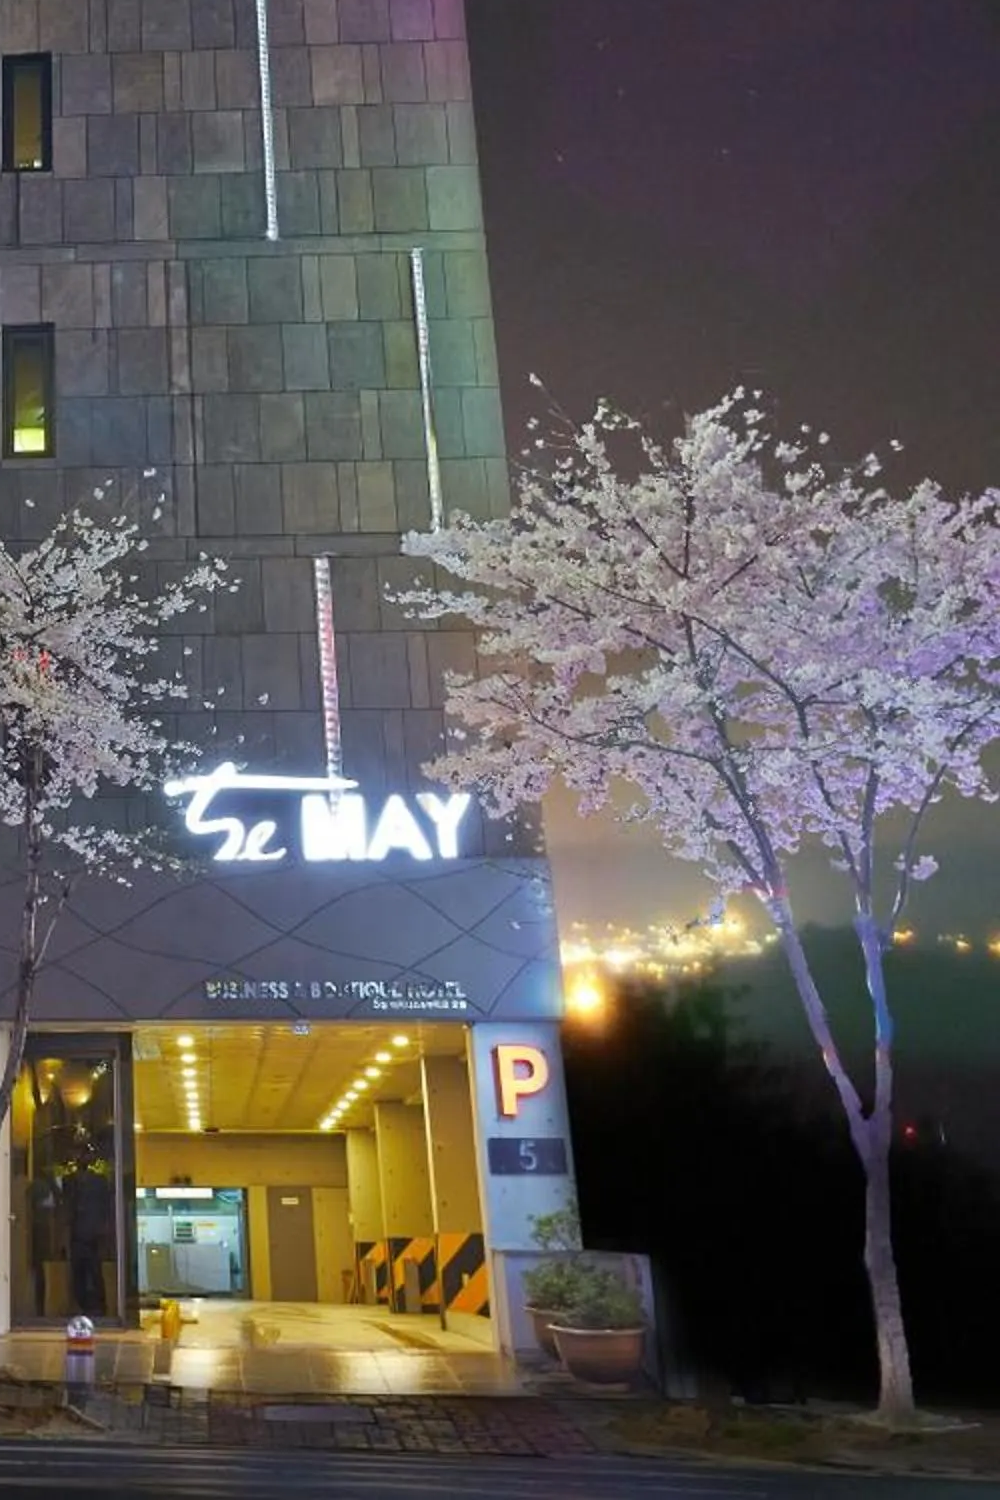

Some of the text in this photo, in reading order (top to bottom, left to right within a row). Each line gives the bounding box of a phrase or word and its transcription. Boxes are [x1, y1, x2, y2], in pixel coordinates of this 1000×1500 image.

[301, 793, 471, 861] MAY
[492, 1044, 549, 1118] P
[519, 1140, 537, 1170] 5
